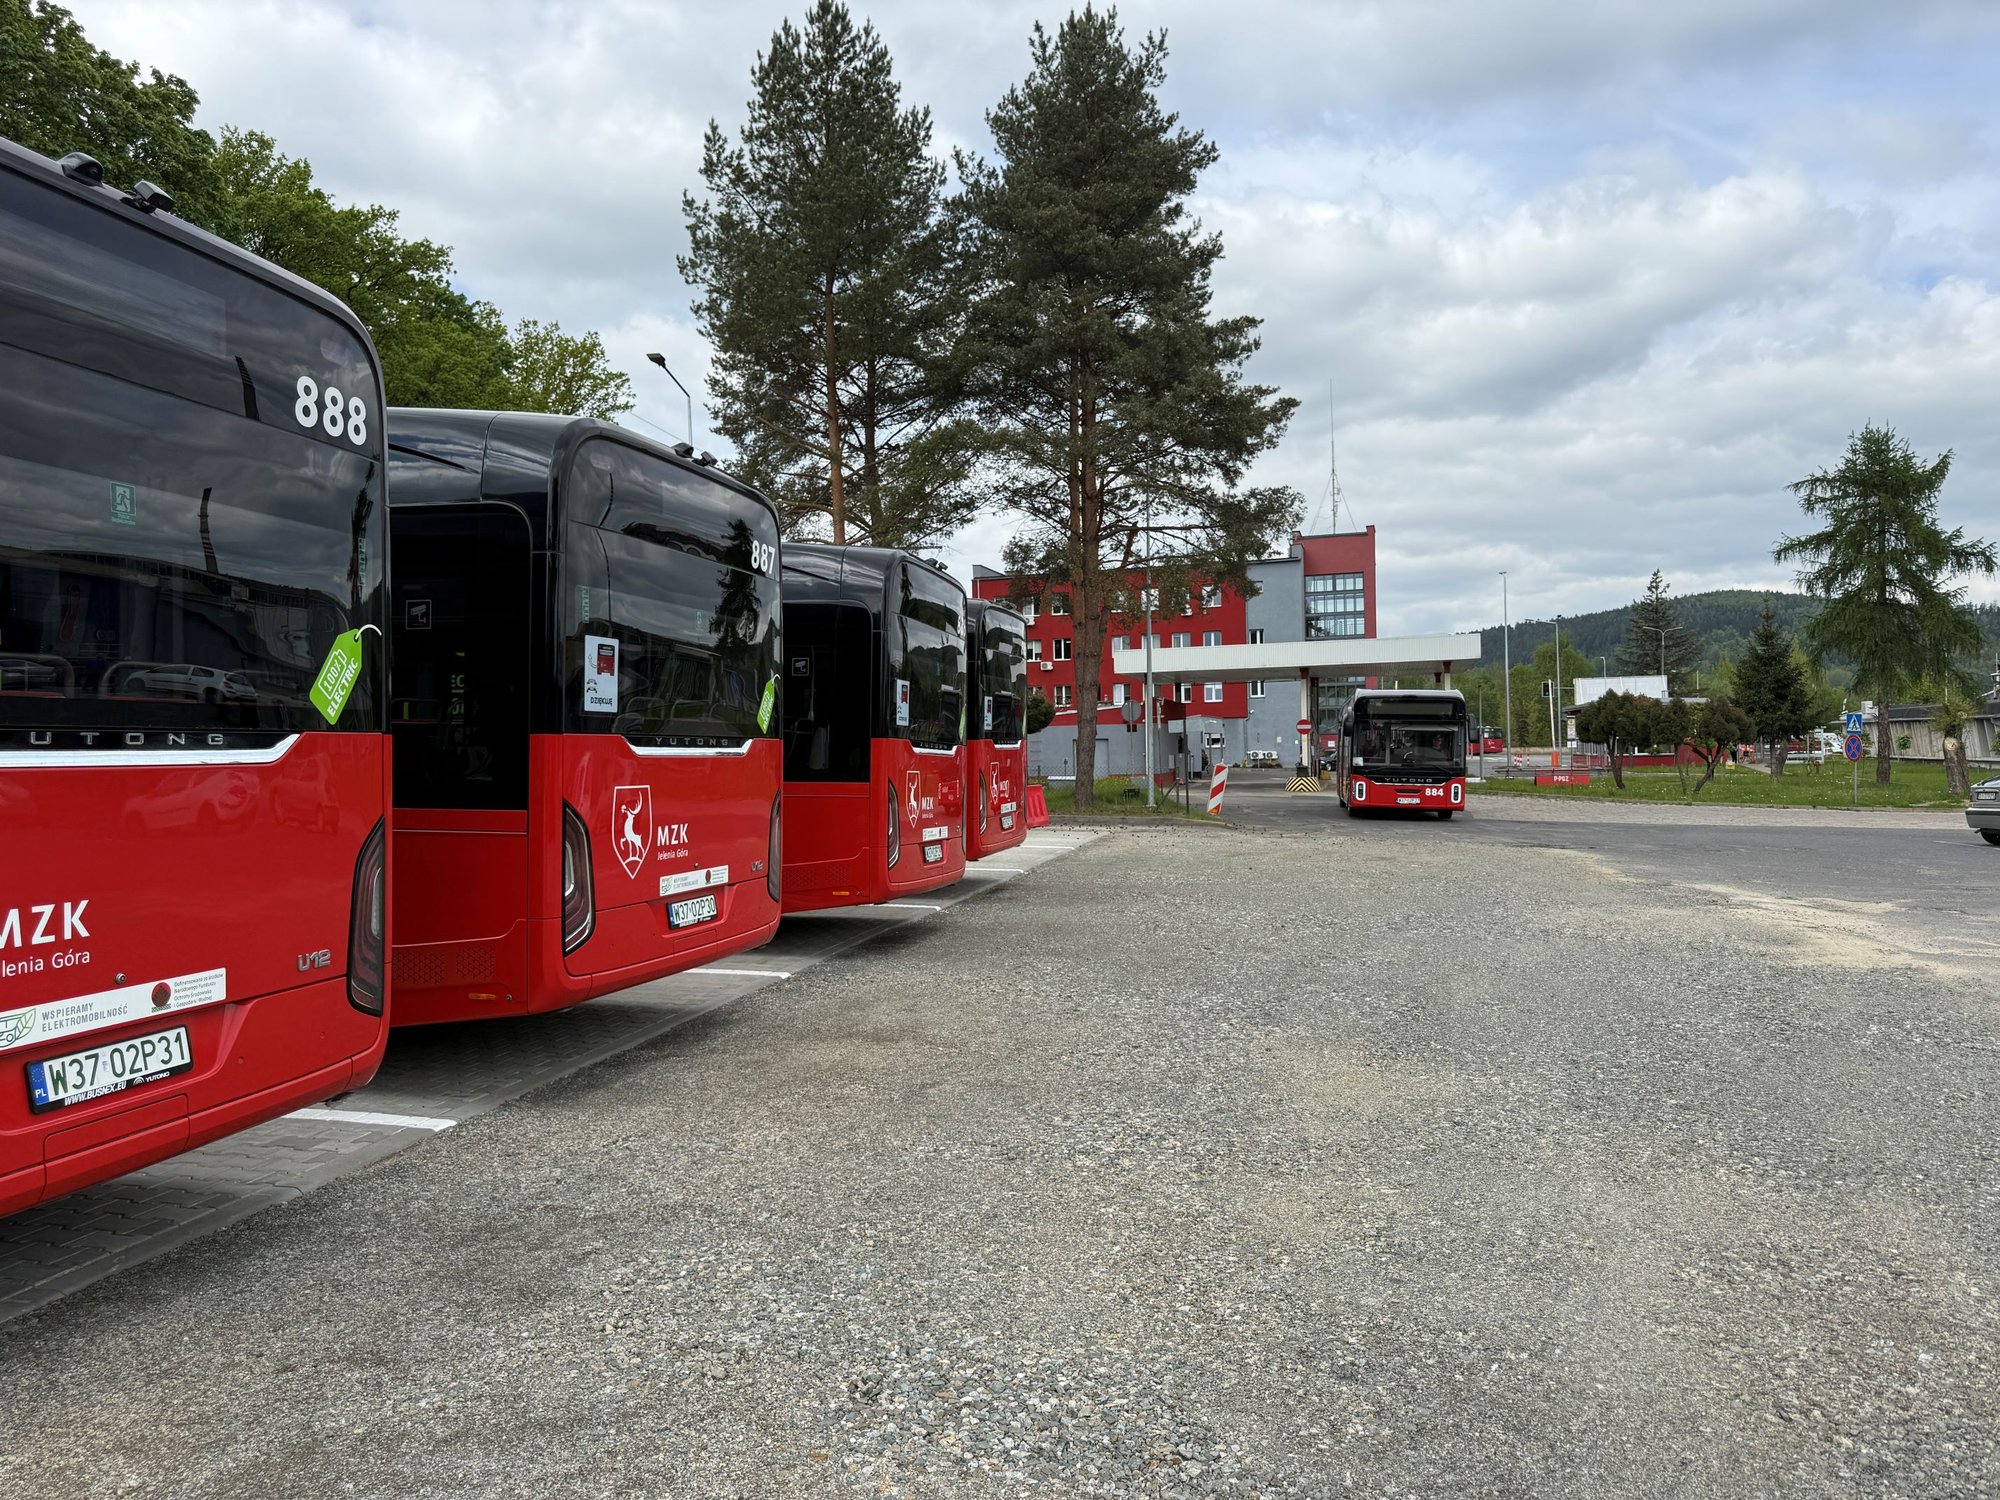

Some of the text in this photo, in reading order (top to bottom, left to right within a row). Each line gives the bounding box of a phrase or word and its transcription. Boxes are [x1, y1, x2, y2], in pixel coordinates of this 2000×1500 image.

[295, 376, 367, 446] 888
[751, 540, 776, 574] 887
[323, 659, 341, 692] 100%
[327, 657, 358, 718] ELECTRIC
[29, 731, 224, 745] UTONG
[655, 737, 729, 746] YUTONG
[1425, 788, 1444, 796] 884
[657, 823, 689, 846] MZK
[0, 900, 91, 949] MZK
[2, 949, 90, 977] lenia Góra
[297, 949, 331, 971] U12
[42, 1002, 94, 1021] WSPIERAMY
[42, 1003, 128, 1032] ELEKTROMOBILNOŚĆ
[48, 1031, 185, 1096] W37 02P31
[145, 1071, 170, 1083] YUTONG
[35, 1088, 47, 1099] PL
[64, 1080, 127, 1106] WWW.BUSNEX.EU
